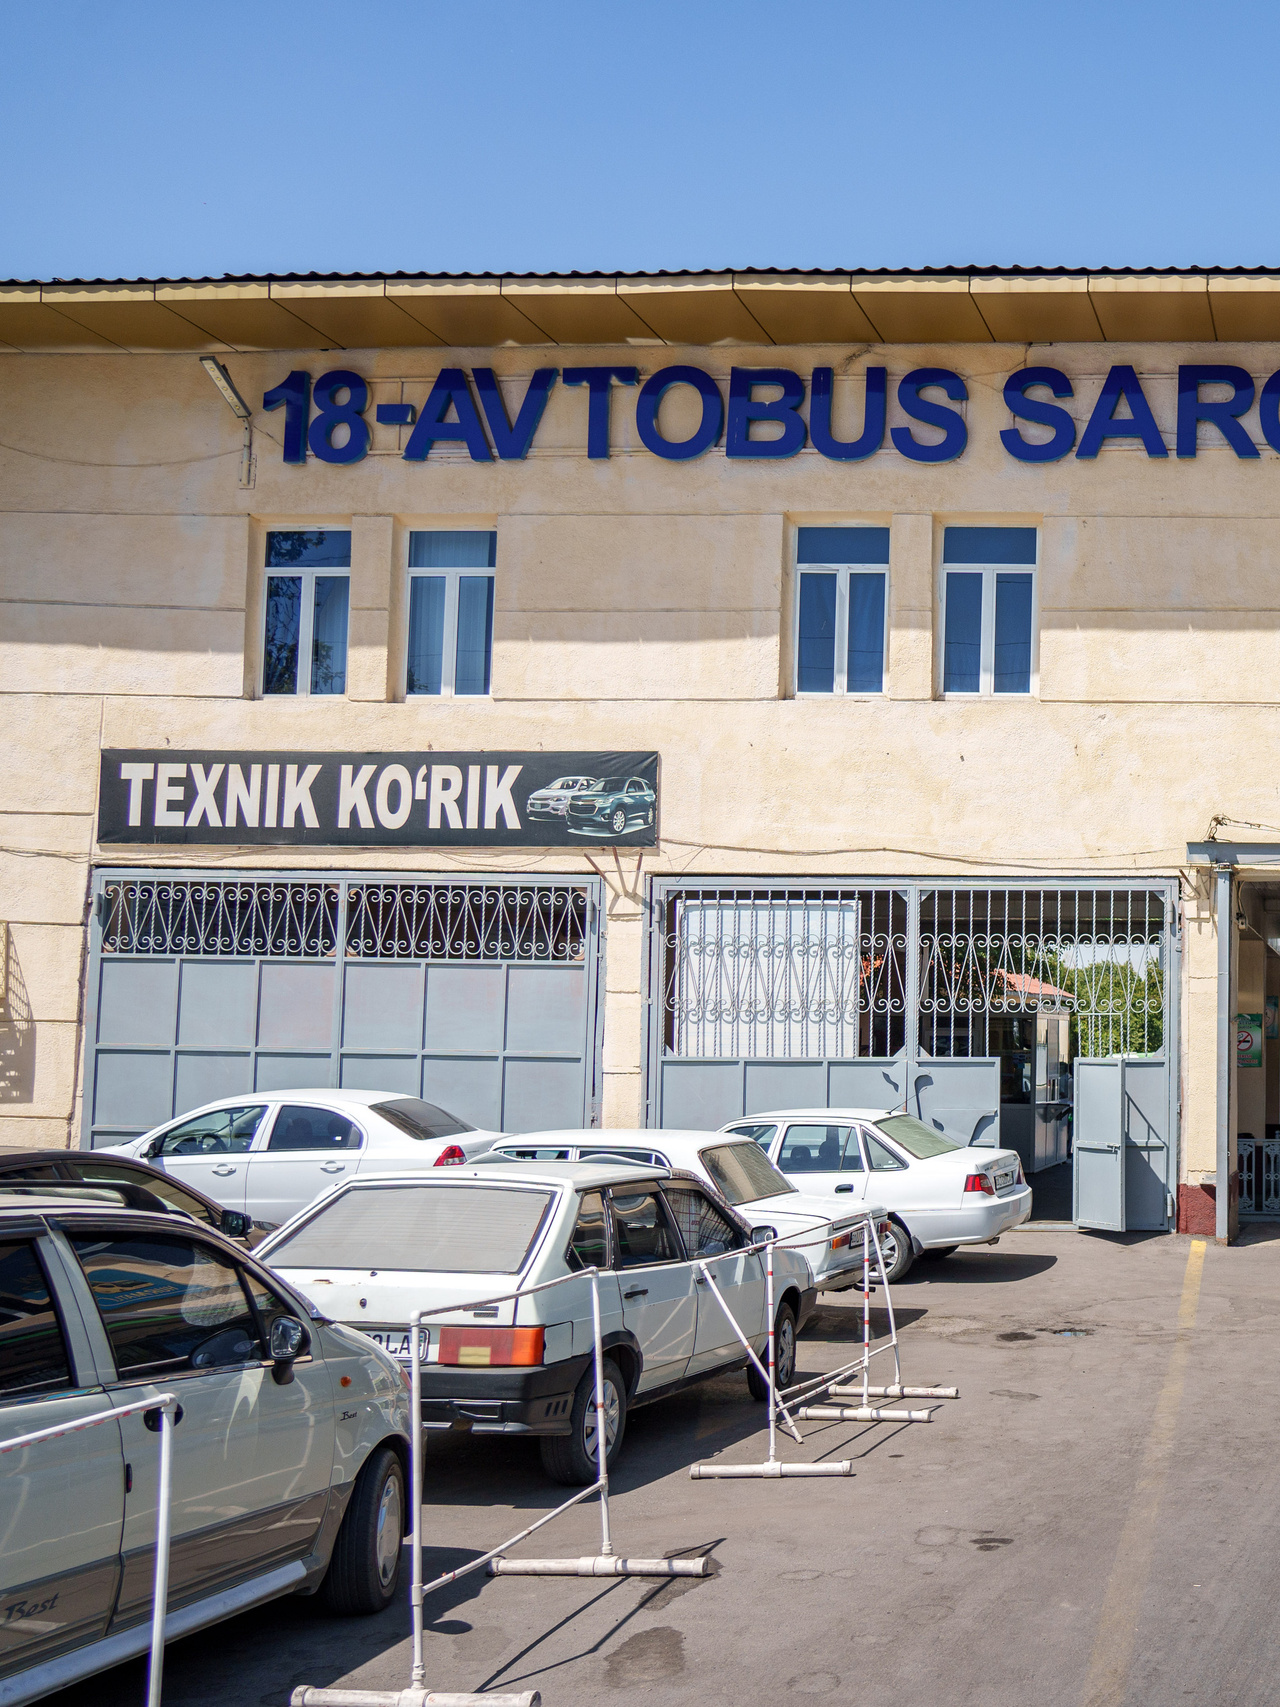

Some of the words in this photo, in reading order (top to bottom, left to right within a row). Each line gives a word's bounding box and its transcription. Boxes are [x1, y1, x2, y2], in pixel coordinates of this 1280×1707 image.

[262, 364, 968, 466] 18-AVTOBUS
[120, 762, 323, 829] TEXNIK
[3, 1592, 60, 1623] Best
